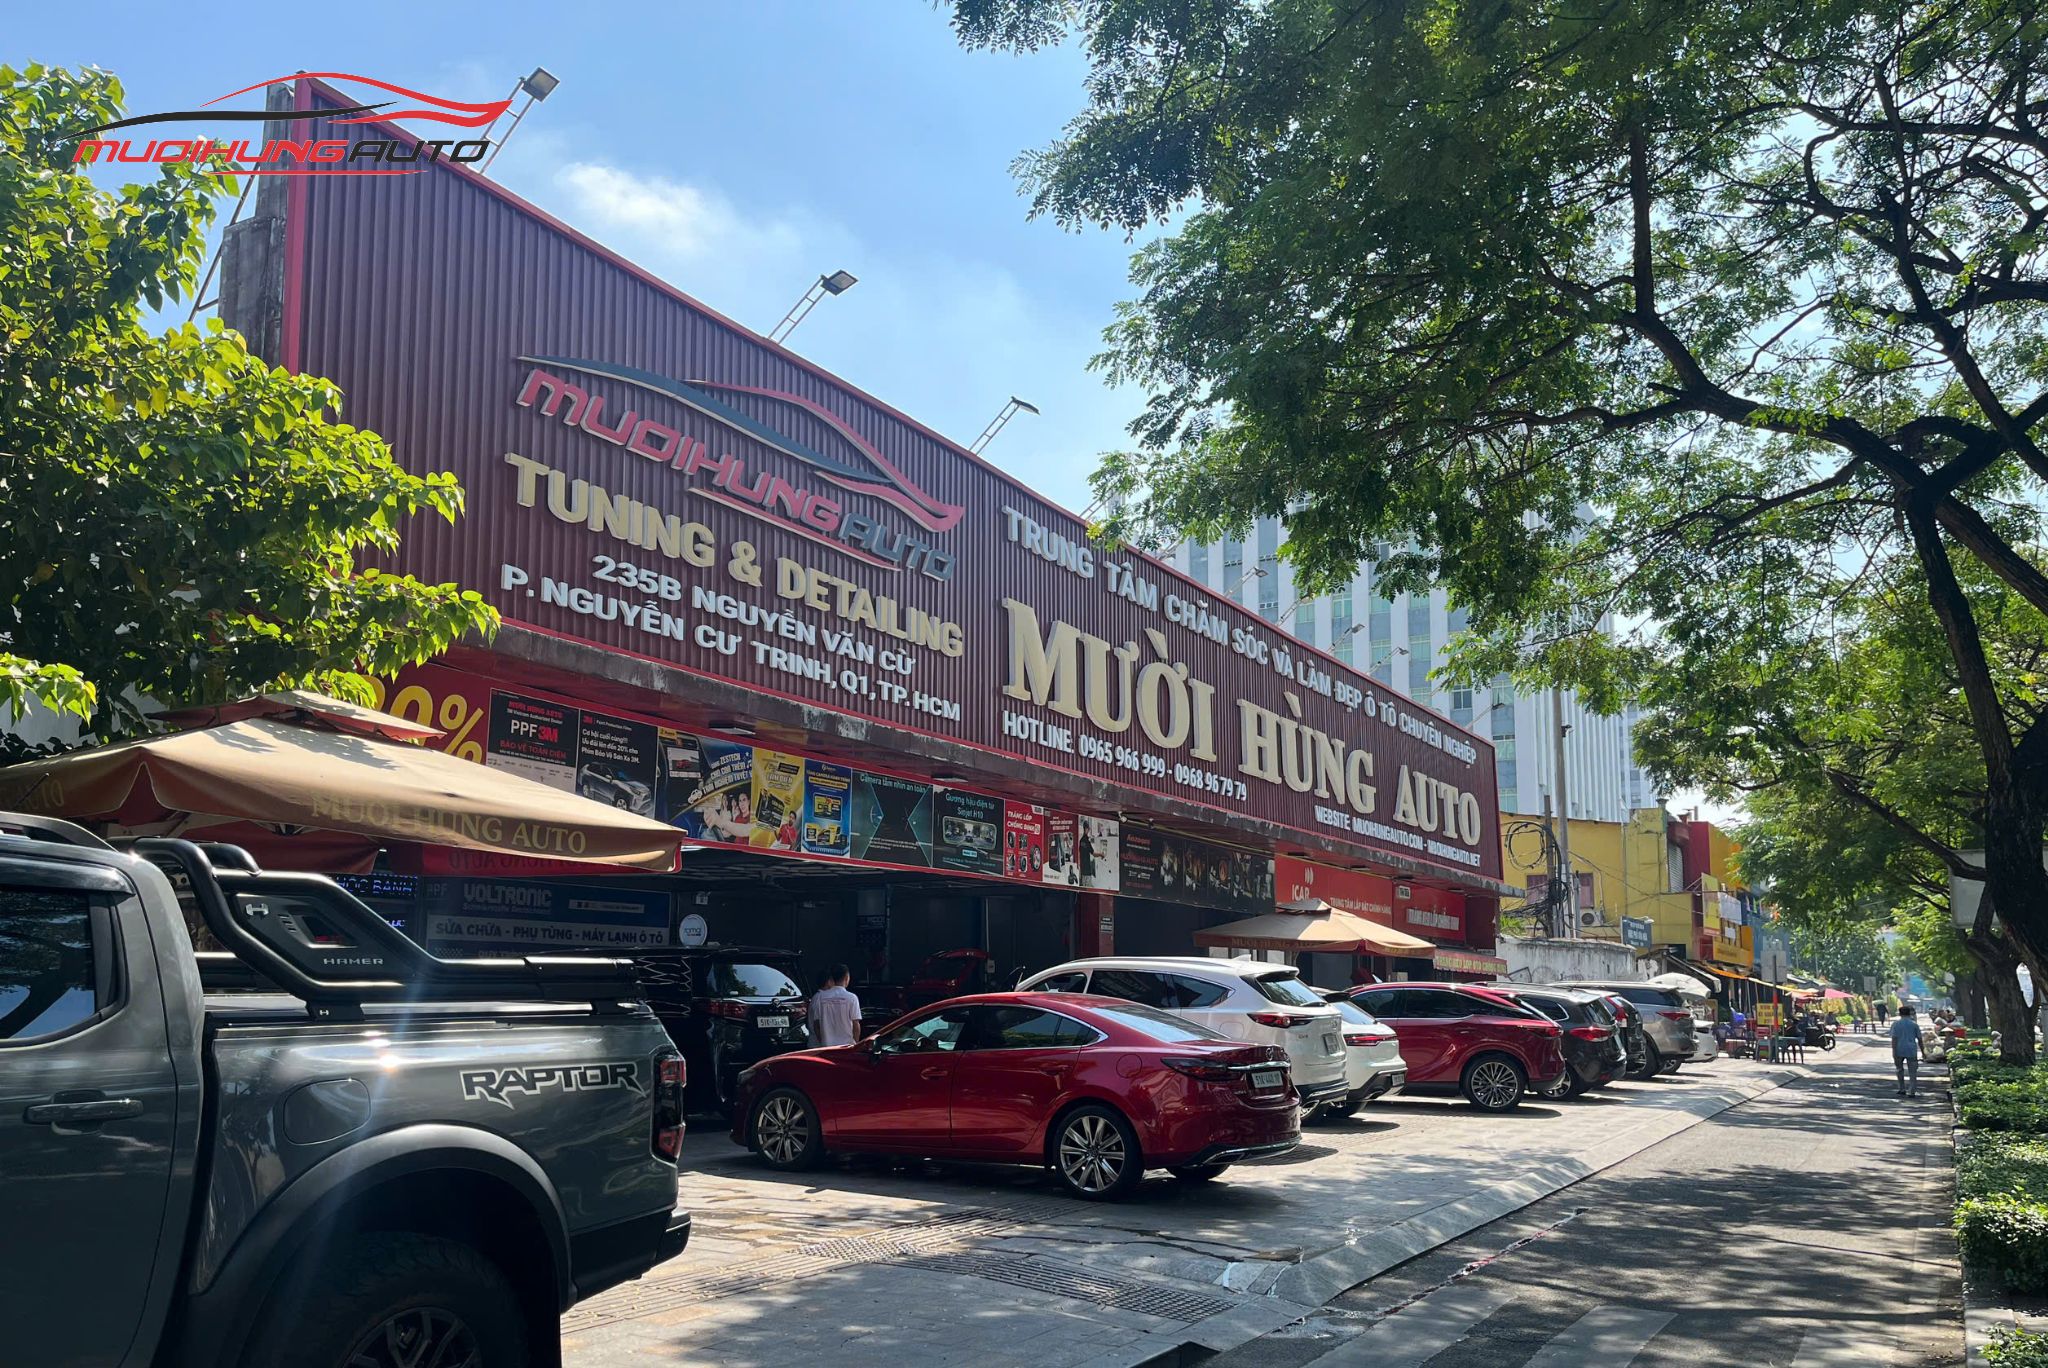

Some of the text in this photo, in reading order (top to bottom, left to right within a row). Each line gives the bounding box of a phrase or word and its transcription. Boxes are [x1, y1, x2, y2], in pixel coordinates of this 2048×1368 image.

[504, 453, 964, 658] TUNING & DETAILING
[501, 564, 534, 597] P.
[541, 577, 684, 641] NGUYỄN
[695, 625, 742, 655] CƯ
[592, 555, 916, 675] 235B NGUYỄN VĂN CỪ
[1002, 505, 1477, 769] TRUNG TÂM CHĂM SÓC VÀ LÀM ĐẸP Ô TÔ CHUYÊN NGHIỆP
[511, 719, 559, 743] PPF 3M
[1002, 598, 1481, 846] MƯỜI HÙNG AUTO
[1079, 735, 1113, 764] 0965
[1115, 745, 1140, 772] 966
[1141, 754, 1165, 778] 999
[1175, 763, 1204, 788] 0968
[511, 821, 586, 855] AUTO
[1292, 884, 1311, 900] ICAR
[323, 957, 384, 966] HAMER
[459, 1061, 648, 1110] RAPTOR
